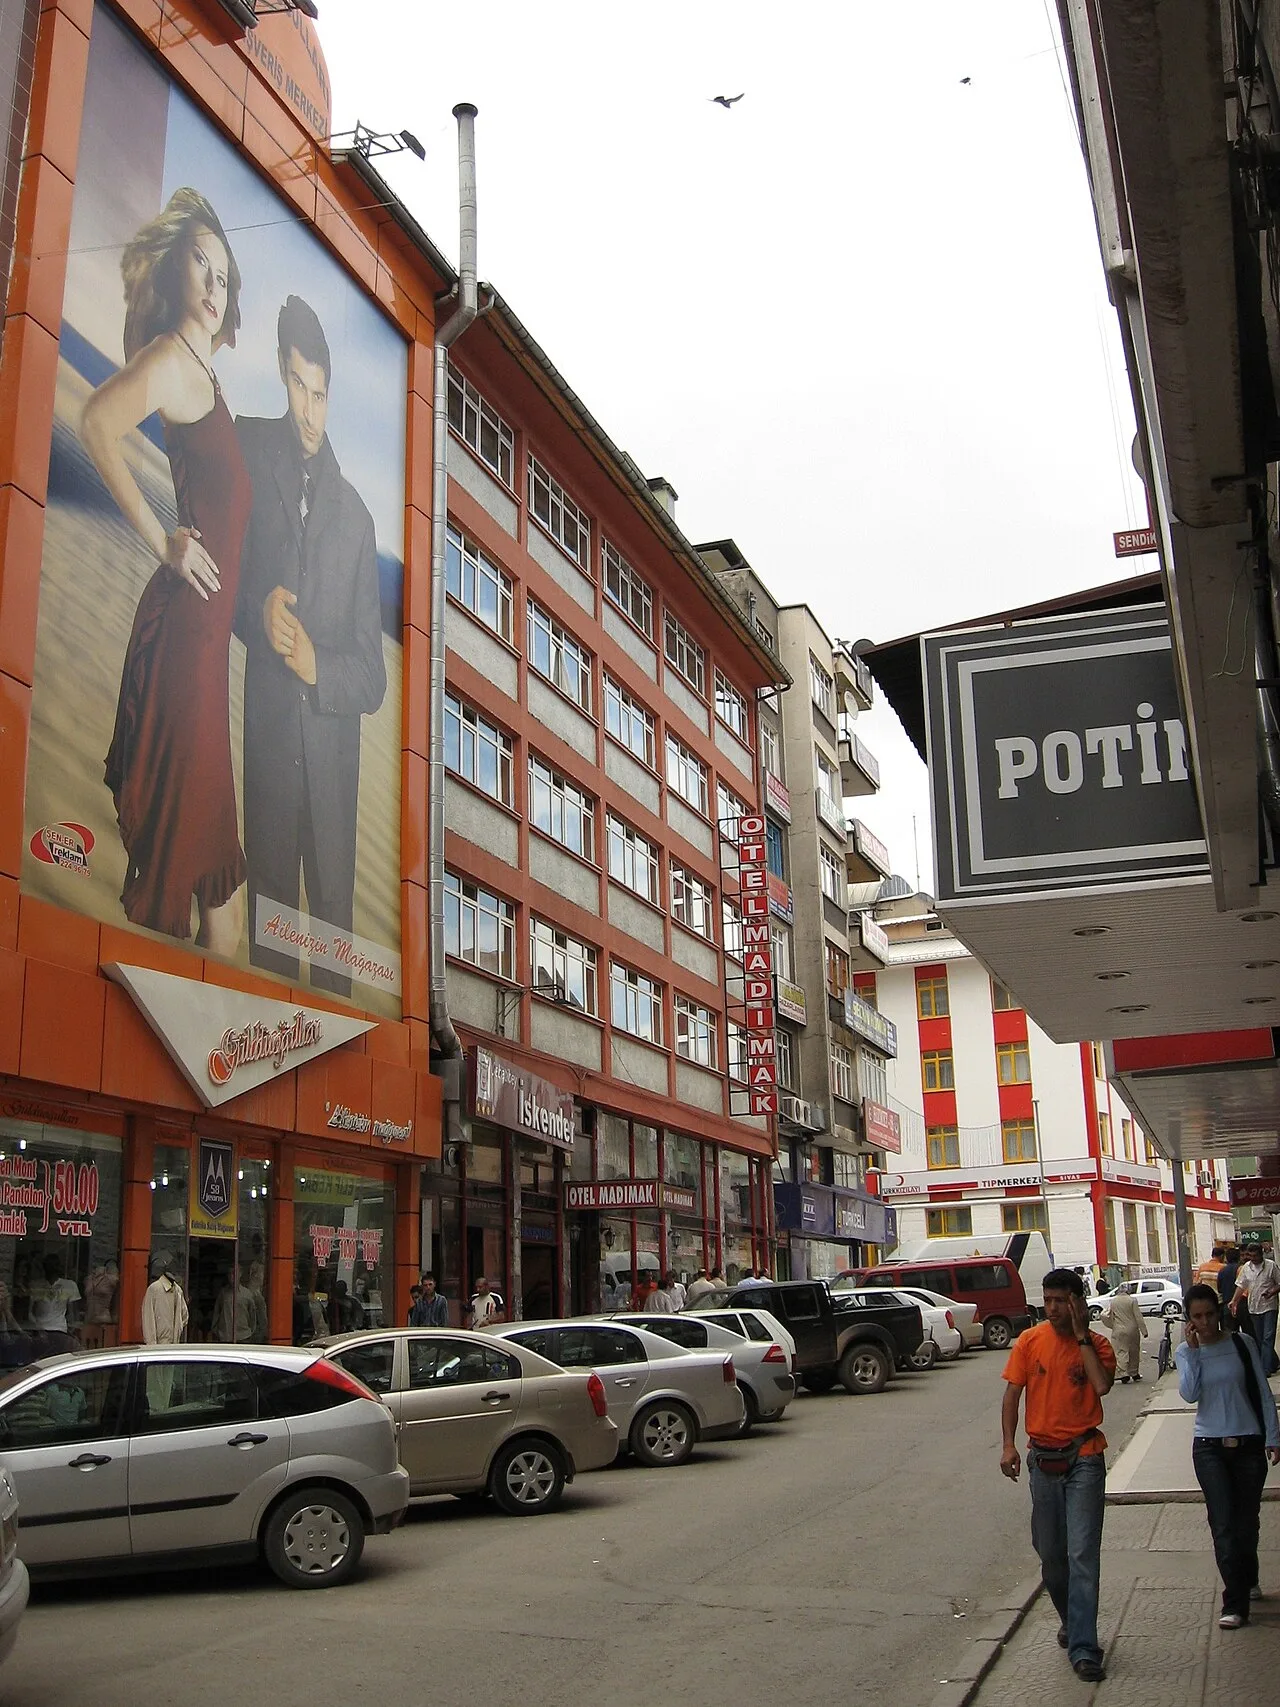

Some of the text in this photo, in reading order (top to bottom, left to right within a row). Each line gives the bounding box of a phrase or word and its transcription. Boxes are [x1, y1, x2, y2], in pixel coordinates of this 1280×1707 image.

[53, 847, 83, 865] reklam
[263, 912, 395, 981] Ailenizin Mağazası
[740, 817, 775, 1112] OTEL MADIMAK
[13, 1156, 37, 1181] Mont
[3, 1181, 45, 1209] Pantolon
[53, 1162, 99, 1217] 50.00
[210, 1184, 220, 1195] 58
[569, 1184, 655, 1206] OTEL MADIMAK
[662, 1190, 674, 1204] OTEL
[57, 1219, 93, 1237] YTL
